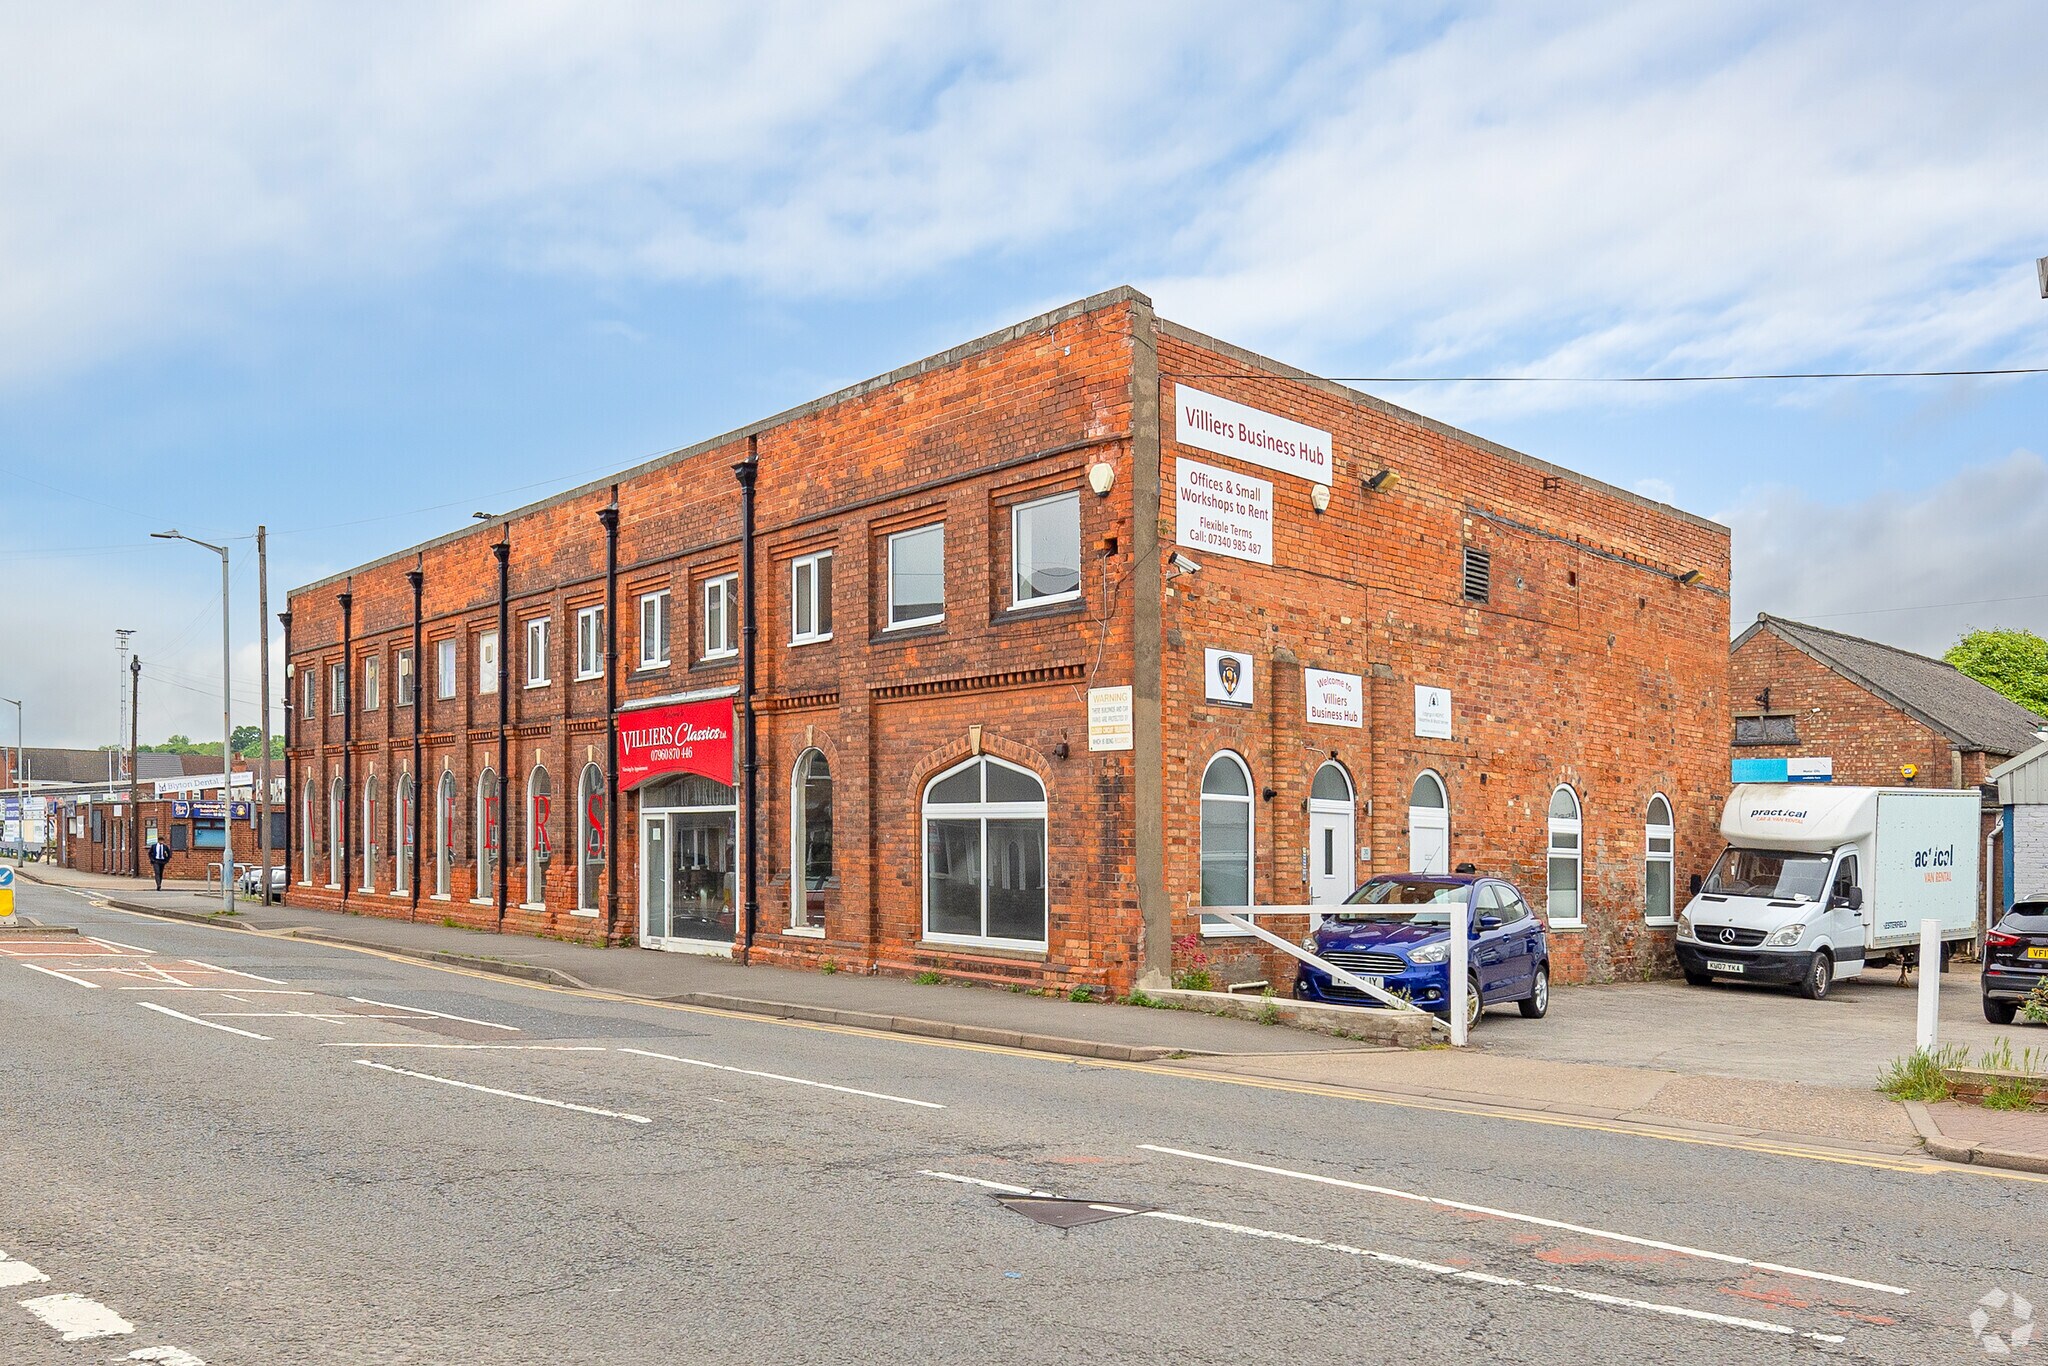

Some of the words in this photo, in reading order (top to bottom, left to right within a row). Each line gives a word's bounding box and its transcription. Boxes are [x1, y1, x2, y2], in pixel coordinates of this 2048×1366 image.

[1185, 406, 1234, 439] Villiers
[1238, 422, 1296, 457] Business
[1299, 441, 1324, 466] Hub
[1190, 471, 1224, 492] Offices
[1226, 480, 1233, 494] &
[1235, 483, 1261, 502] Small
[1180, 486, 1234, 514] Workshops
[1236, 501, 1246, 516] to
[1248, 504, 1269, 521] Rent
[1199, 516, 1229, 534] Flexible
[1230, 523, 1253, 539] Terms
[1189, 528, 1207, 543] Call:
[1208, 532, 1232, 549] 07340
[1232, 538, 1247, 552] 985
[1248, 542, 1262, 555] 487
[1317, 676, 1345, 688] Welcome
[1345, 682, 1352, 692] to
[1093, 692, 1128, 703] WARNING
[1323, 692, 1348, 707] Villiers
[1311, 705, 1343, 721] Business
[1343, 710, 1359, 723] Hub
[622, 726, 673, 756] VILLIERS
[674, 722, 721, 747] Classics
[650, 747, 669, 762] 07960
[681, 746, 693, 759] 446
[168, 781, 193, 791] Blyton
[194, 778, 219, 787] Dental
[1750, 809, 1807, 819] practical
[1924, 872, 1935, 883] VAN
[1935, 871, 1952, 883] RENTAL
[2032, 949, 2048, 958] VF1
